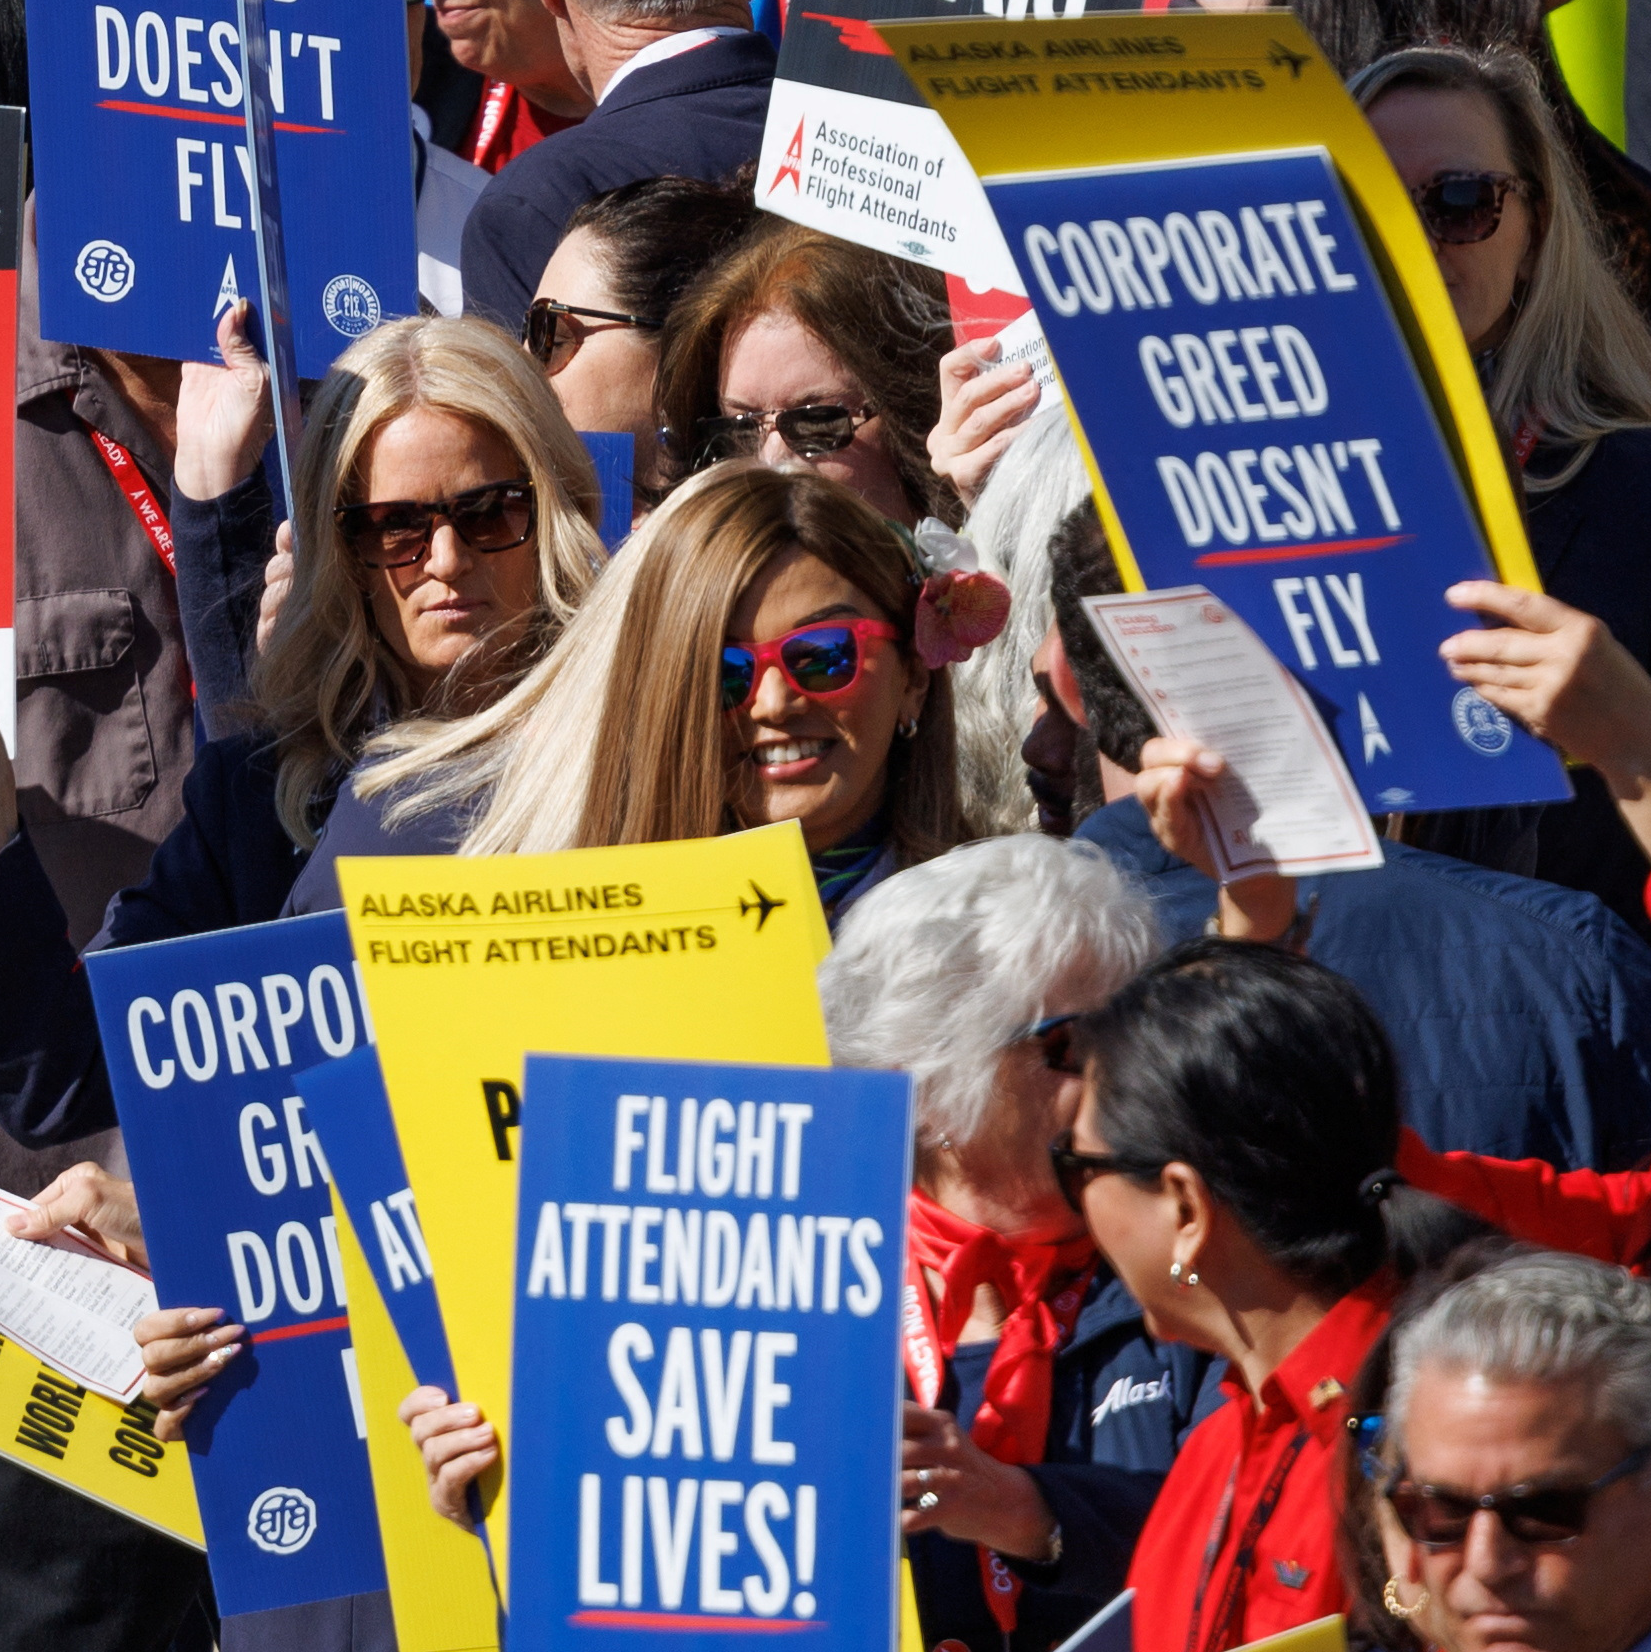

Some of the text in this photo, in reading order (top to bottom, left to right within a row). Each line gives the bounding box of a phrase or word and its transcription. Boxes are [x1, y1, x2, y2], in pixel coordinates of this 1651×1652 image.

[908, 36, 1187, 66] ALASKA AIRLINES
[930, 68, 1268, 96] FLIGHT ATTENDANTS
[811, 148, 921, 201] Professional
[816, 121, 944, 178] Association of
[807, 176, 957, 242] Flight Attendants
[1024, 200, 1357, 317] CORPORATE
[1139, 325, 1328, 428] GREED
[139, 499, 159, 524] WE
[151, 525, 173, 551] ARE
[1157, 439, 1401, 546] DOESN'T
[1273, 573, 1380, 670] FLY
[361, 884, 643, 917] ALASKA AIRLINES
[369, 926, 716, 964] FLIGHT ATTENDANTS
[614, 1095, 813, 1200] FLIGHT
[528, 1202, 883, 1316] ATTENDANTS
[606, 1323, 797, 1464] SAVE
[579, 1474, 816, 1618] LIVES!
